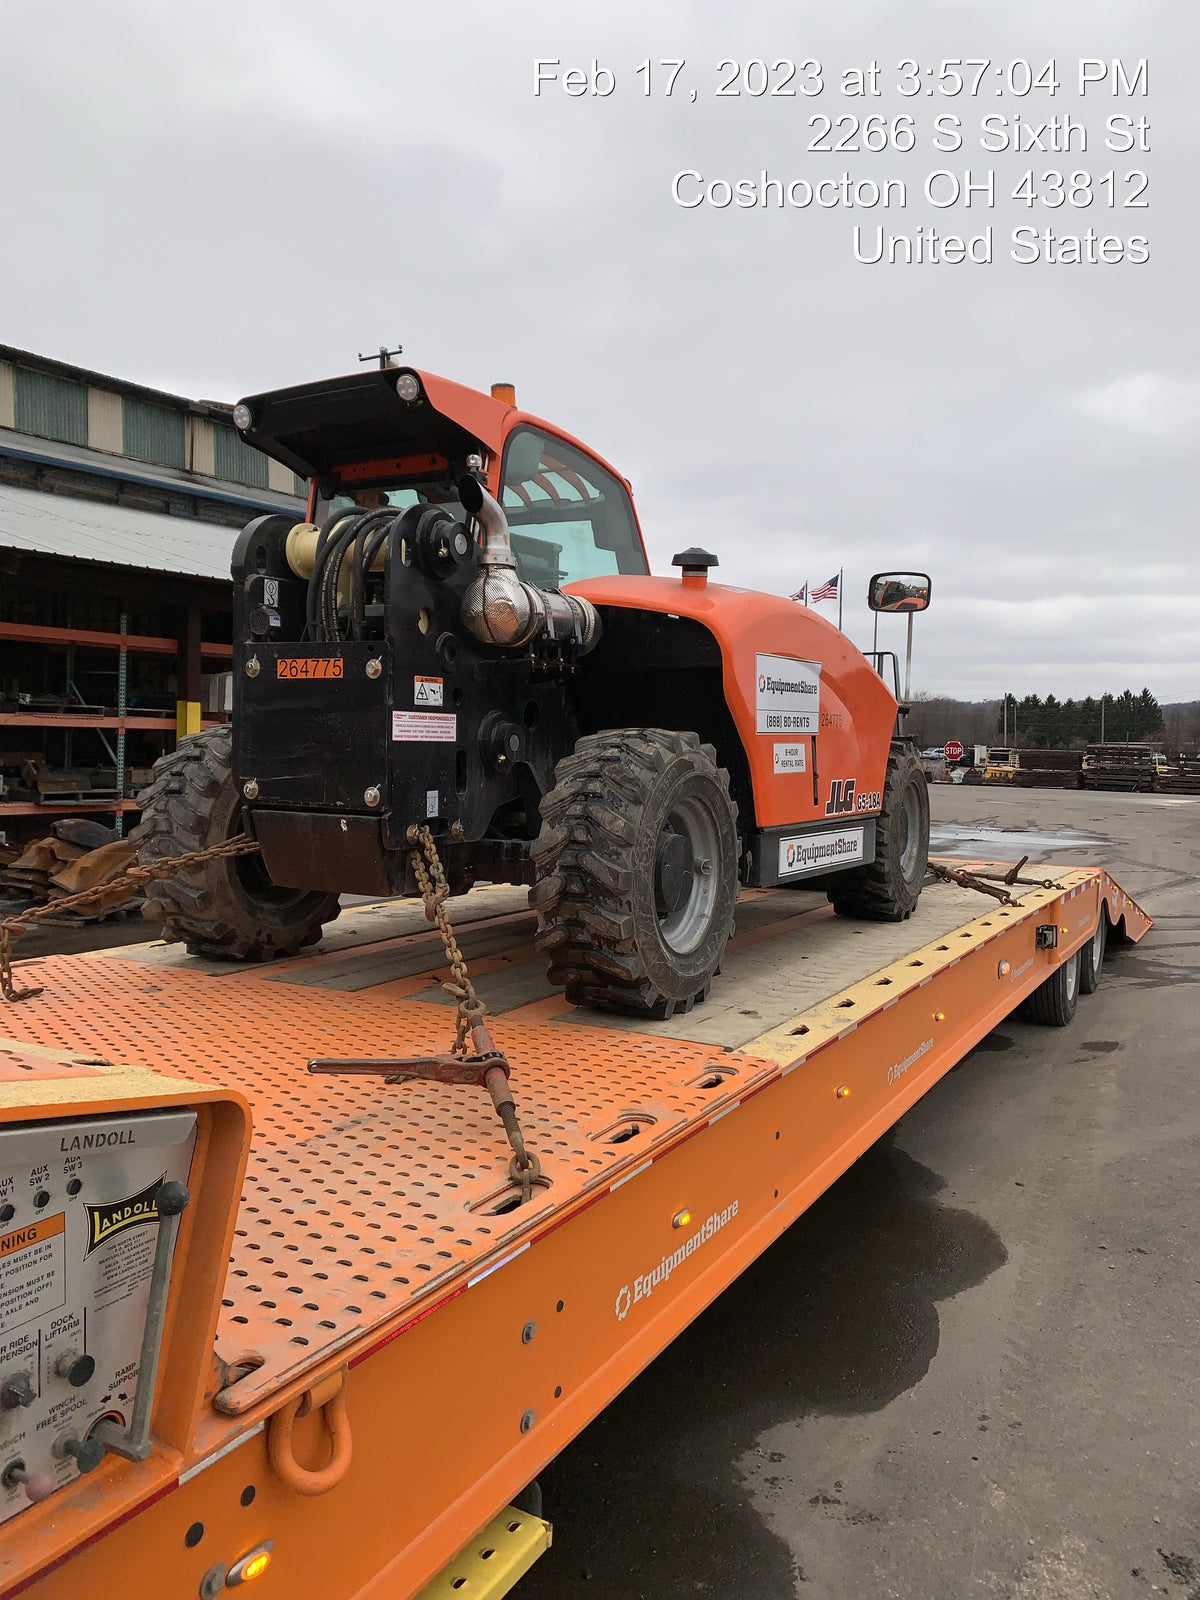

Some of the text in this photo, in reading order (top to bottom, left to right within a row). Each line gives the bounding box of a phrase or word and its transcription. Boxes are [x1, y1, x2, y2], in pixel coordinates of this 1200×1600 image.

[279, 660, 342, 677] 264775
[766, 677, 818, 695] EquipmentShare
[766, 714, 783, 729] (888)
[945, 746, 962, 755] STOP
[825, 779, 856, 816] JLG
[796, 838, 858, 865] EquipmentShare
[60, 1130, 136, 1152] LANDOLL
[31, 1164, 48, 1177] AUX
[63, 1161, 83, 1175] SW 3
[30, 1173, 50, 1187] SW 2
[94, 1199, 158, 1243] LANDOLL
[1, 1228, 37, 1252] NING
[13, 1252, 31, 1264] MUST
[34, 1246, 42, 1256] BE
[45, 1243, 52, 1251] IN
[633, 1199, 739, 1305] EquipmentShare
[5, 1252, 53, 1277] POSITION FOR
[0, 1284, 24, 1300] ENSION
[26, 1276, 44, 1287] MUST
[46, 1270, 56, 1280] BE
[1, 1281, 53, 1309] POSITION (OFF)
[5, 1303, 23, 1317] AXLE
[25, 1296, 39, 1308] AND
[44, 1318, 80, 1341] LIFTARM
[51, 1312, 74, 1330] DOCK
[0, 1339, 38, 1364] PENSION
[9, 1334, 29, 1350] RIDE
[108, 1369, 138, 1392] SUPPOR
[115, 1362, 136, 1379] RAMP
[36, 1398, 88, 1431] FREE SPOOL
[48, 1395, 76, 1416] WINCH
